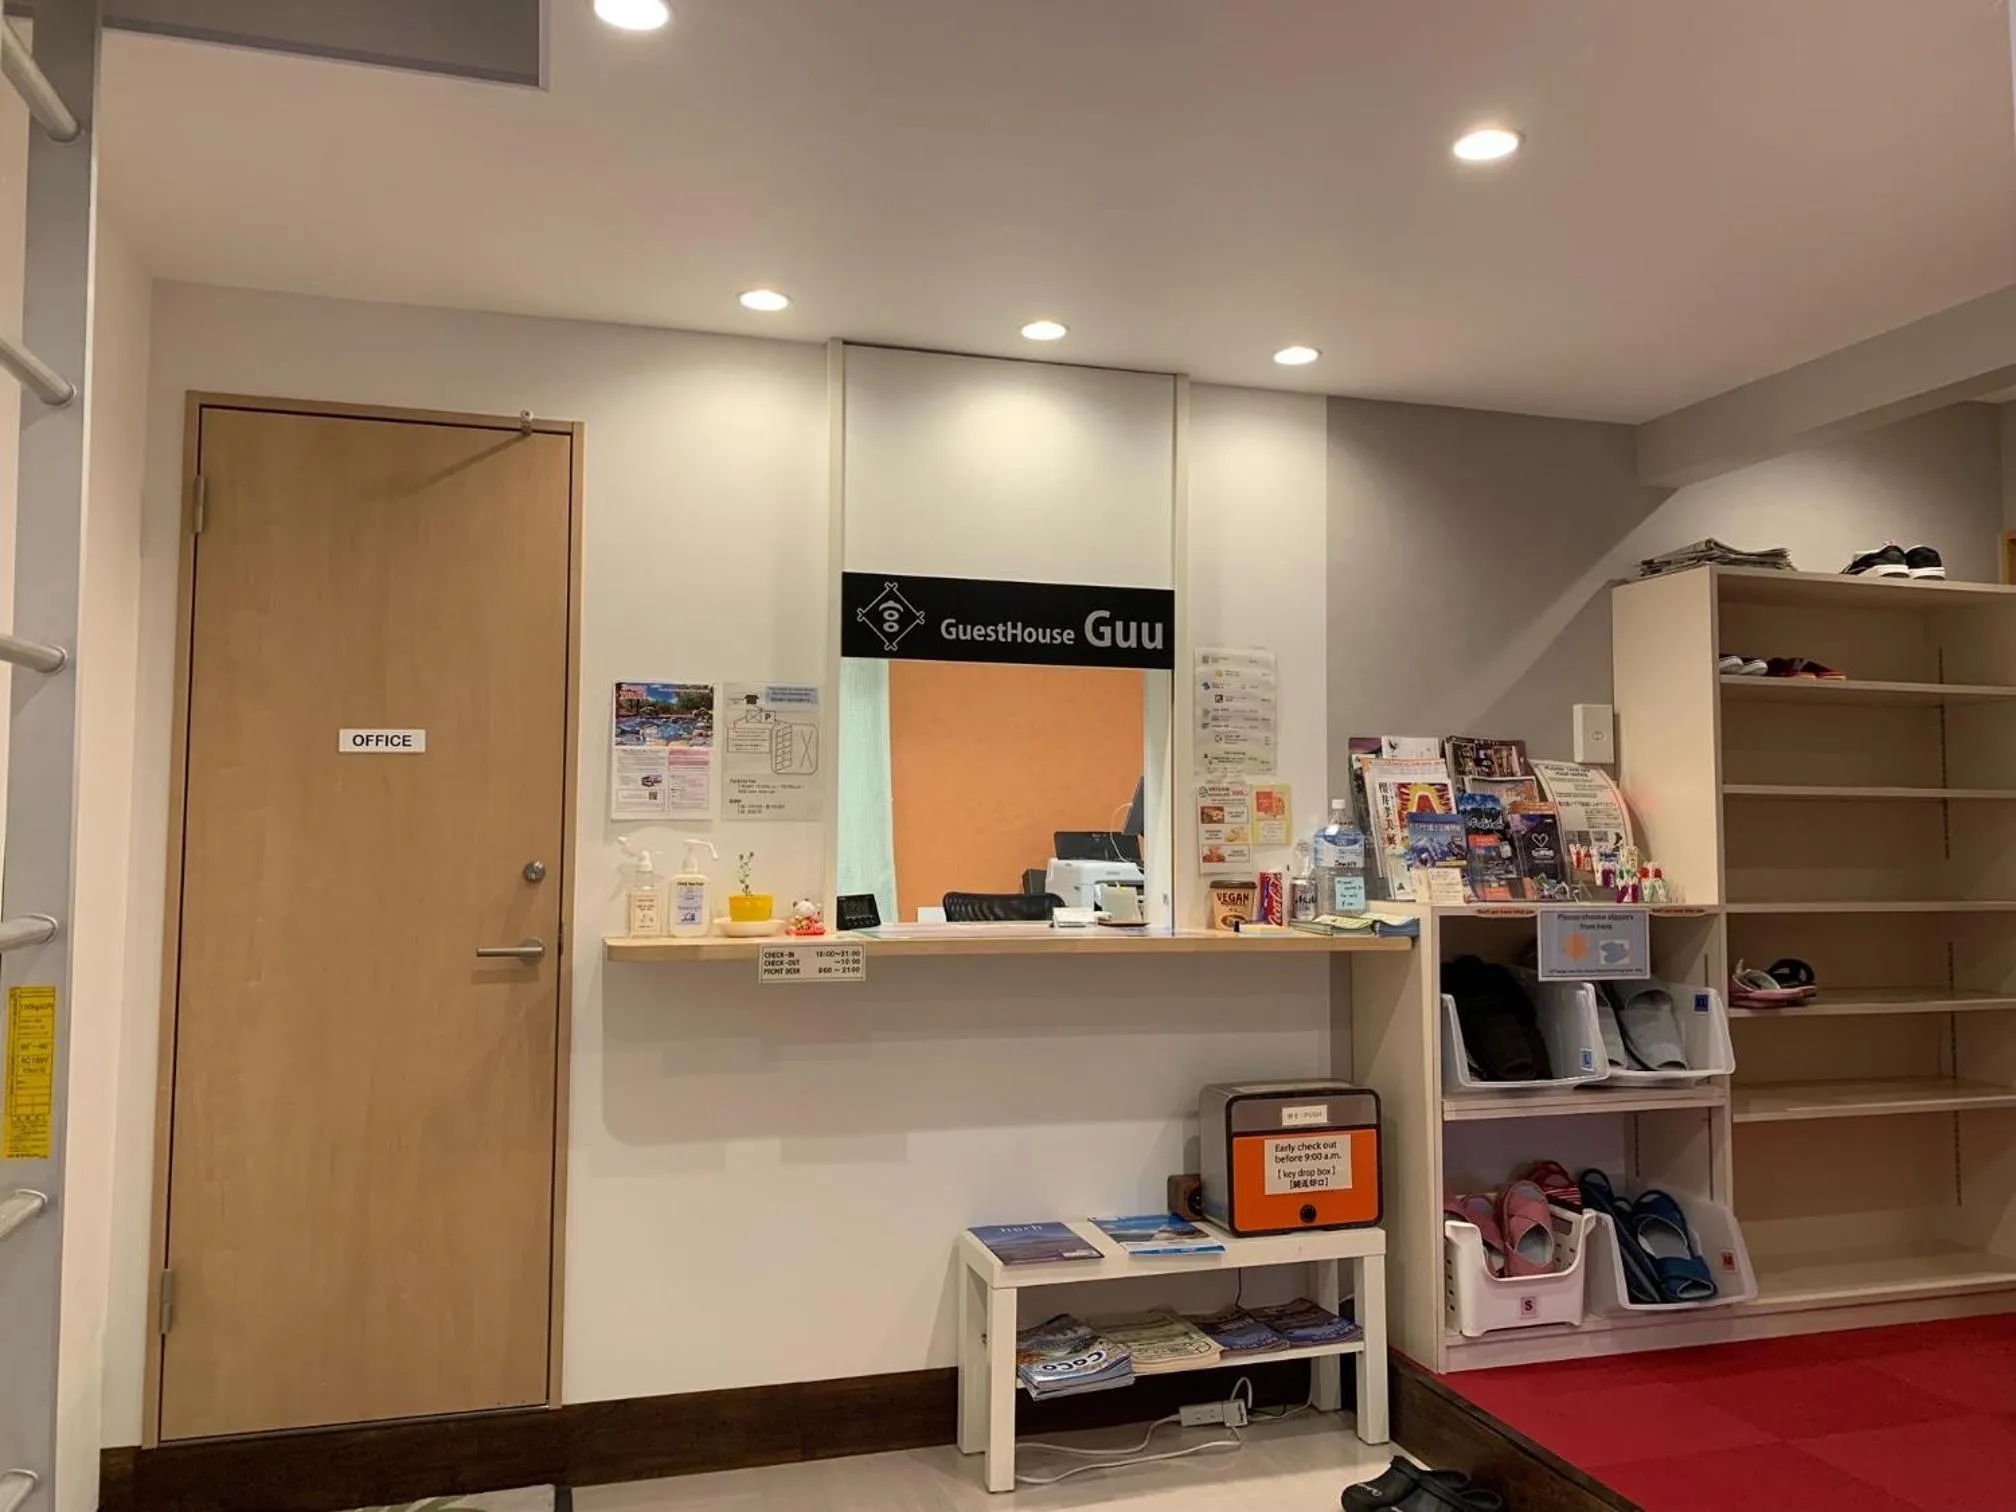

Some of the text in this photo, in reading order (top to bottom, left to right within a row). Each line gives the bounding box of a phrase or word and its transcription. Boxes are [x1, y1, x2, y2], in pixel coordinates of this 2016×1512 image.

[940, 610, 1163, 649] GuestHouse Guu
[352, 734, 412, 747] OFFICE
[1216, 892, 1249, 904] VEGAN
[1608, 913, 1633, 922] slippers
[764, 951, 795, 959] CHECK-IN
[1275, 1141, 1337, 1153] Early check out
[1275, 1152, 1341, 1163] before 9:00 a.m.
[1298, 1168, 1315, 1179] drop
[1524, 1300, 1533, 1311] S
